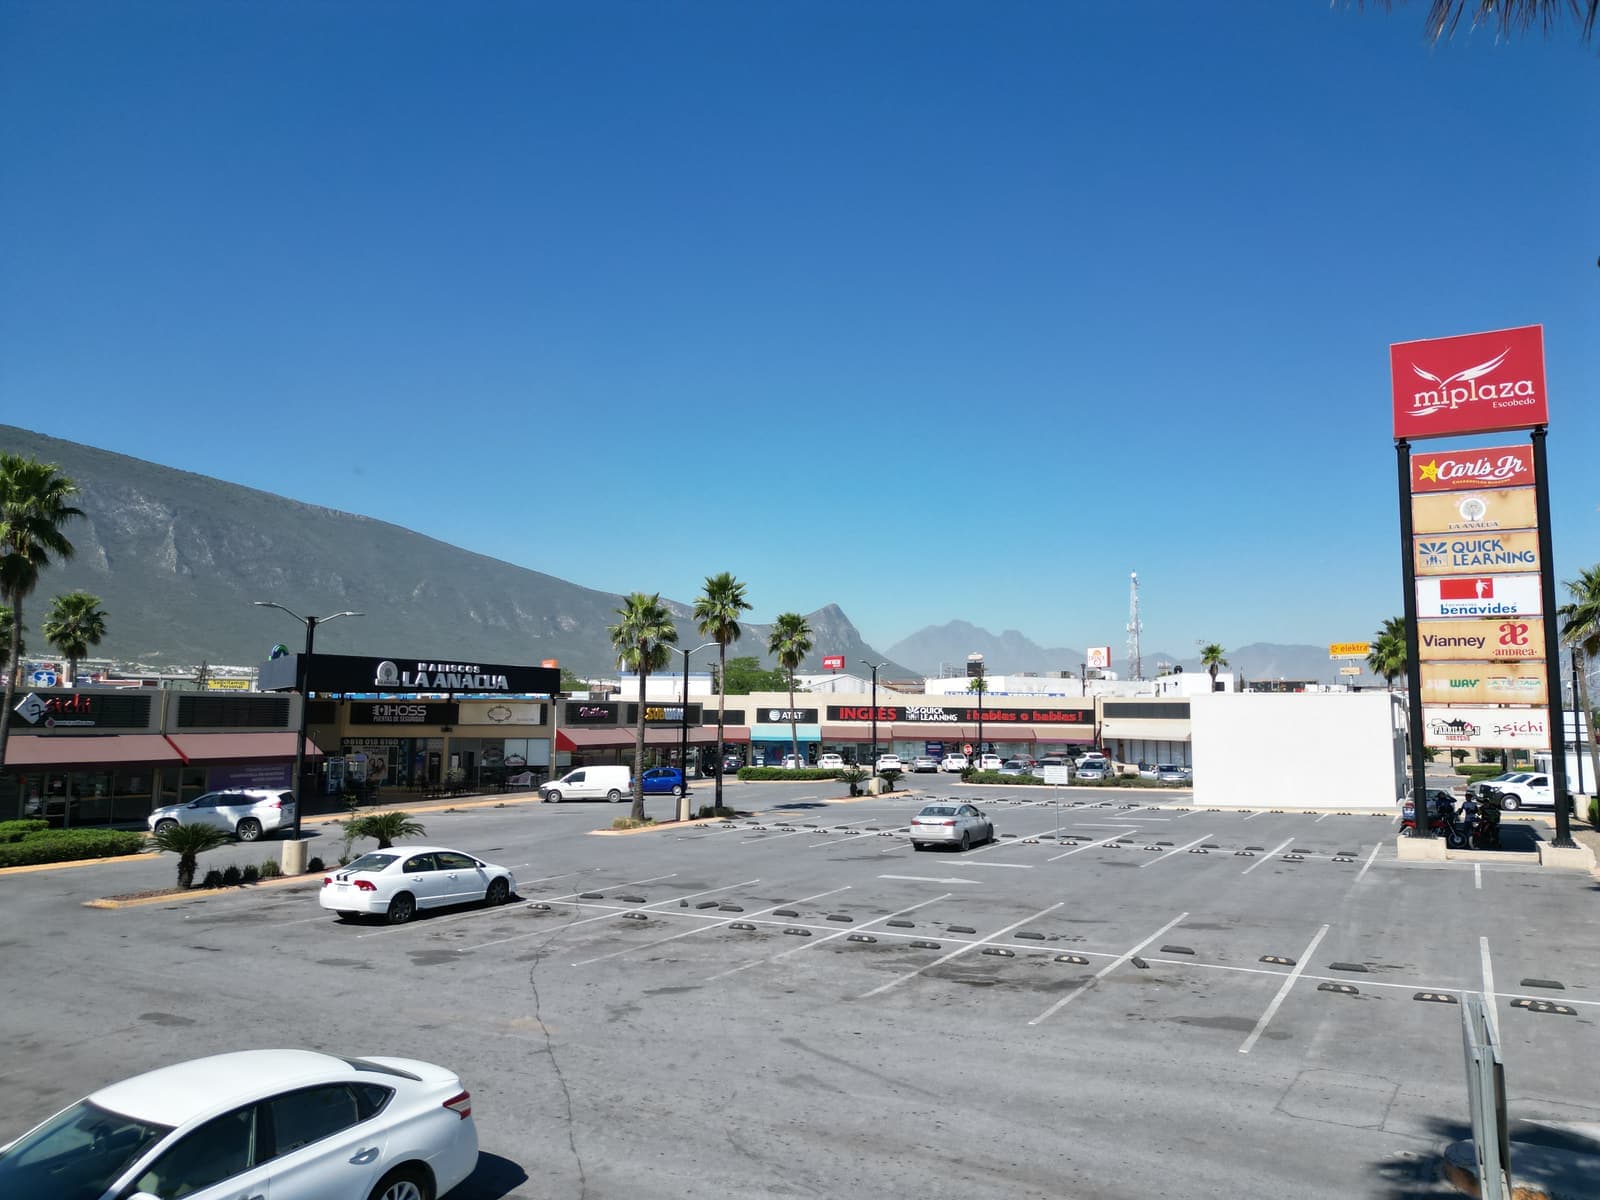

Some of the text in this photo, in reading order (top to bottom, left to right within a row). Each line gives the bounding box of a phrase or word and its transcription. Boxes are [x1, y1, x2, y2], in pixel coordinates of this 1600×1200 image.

[1413, 379, 1534, 409] miplaza
[1492, 398, 1536, 408] Escobedo
[1437, 455, 1527, 480] Carl's Jr.
[1451, 539, 1504, 554] QUICK
[1453, 550, 1535, 567] LEARNING
[1440, 602, 1518, 615] benavides
[1423, 635, 1486, 649] Vianney
[402, 671, 509, 690] LA ANACUA
[1427, 679, 1480, 688] UWAY
[388, 705, 427, 716] HOSS
[1434, 726, 1480, 735] PARRILLN
